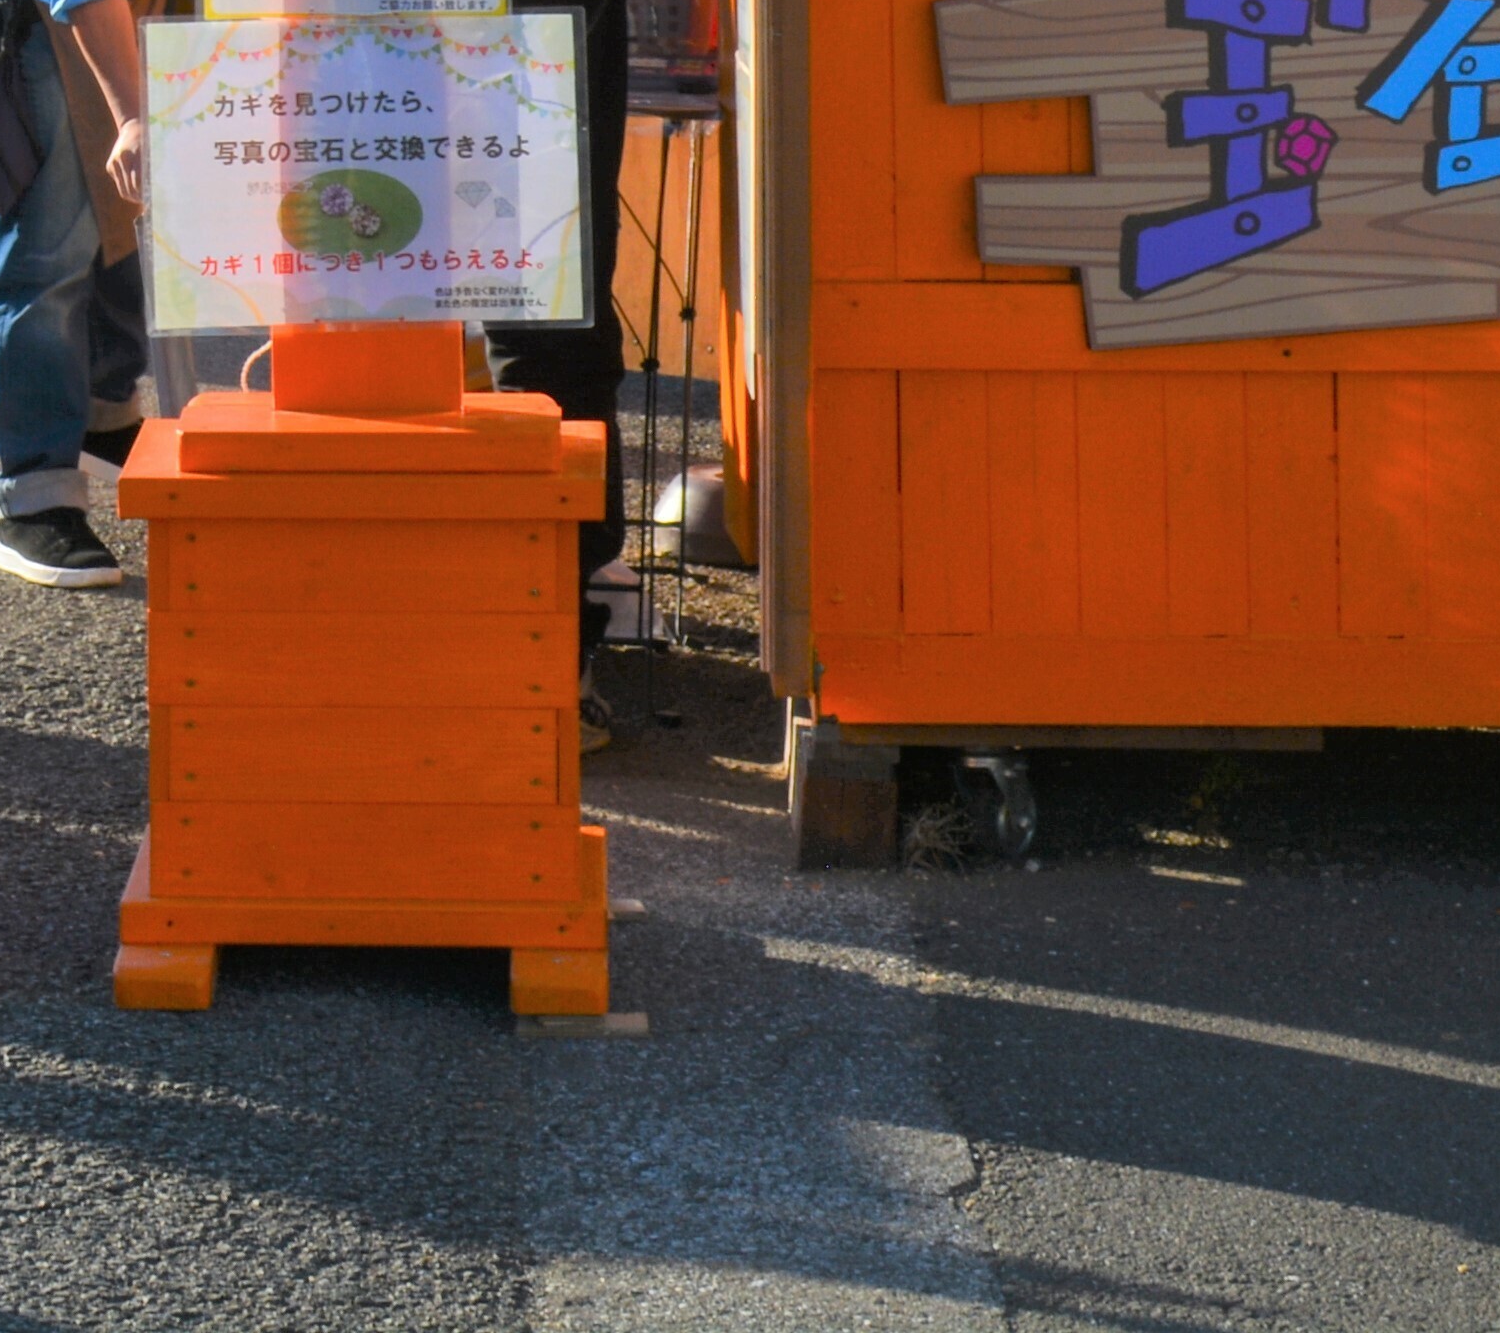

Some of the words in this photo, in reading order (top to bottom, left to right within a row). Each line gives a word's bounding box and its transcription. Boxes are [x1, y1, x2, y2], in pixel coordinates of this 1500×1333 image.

[214, 89, 436, 118] カギを見つけたら、
[214, 134, 531, 165] 写真の宝石と交換できるよ
[200, 248, 546, 277] カギ1個につき1つもらえるよ。
